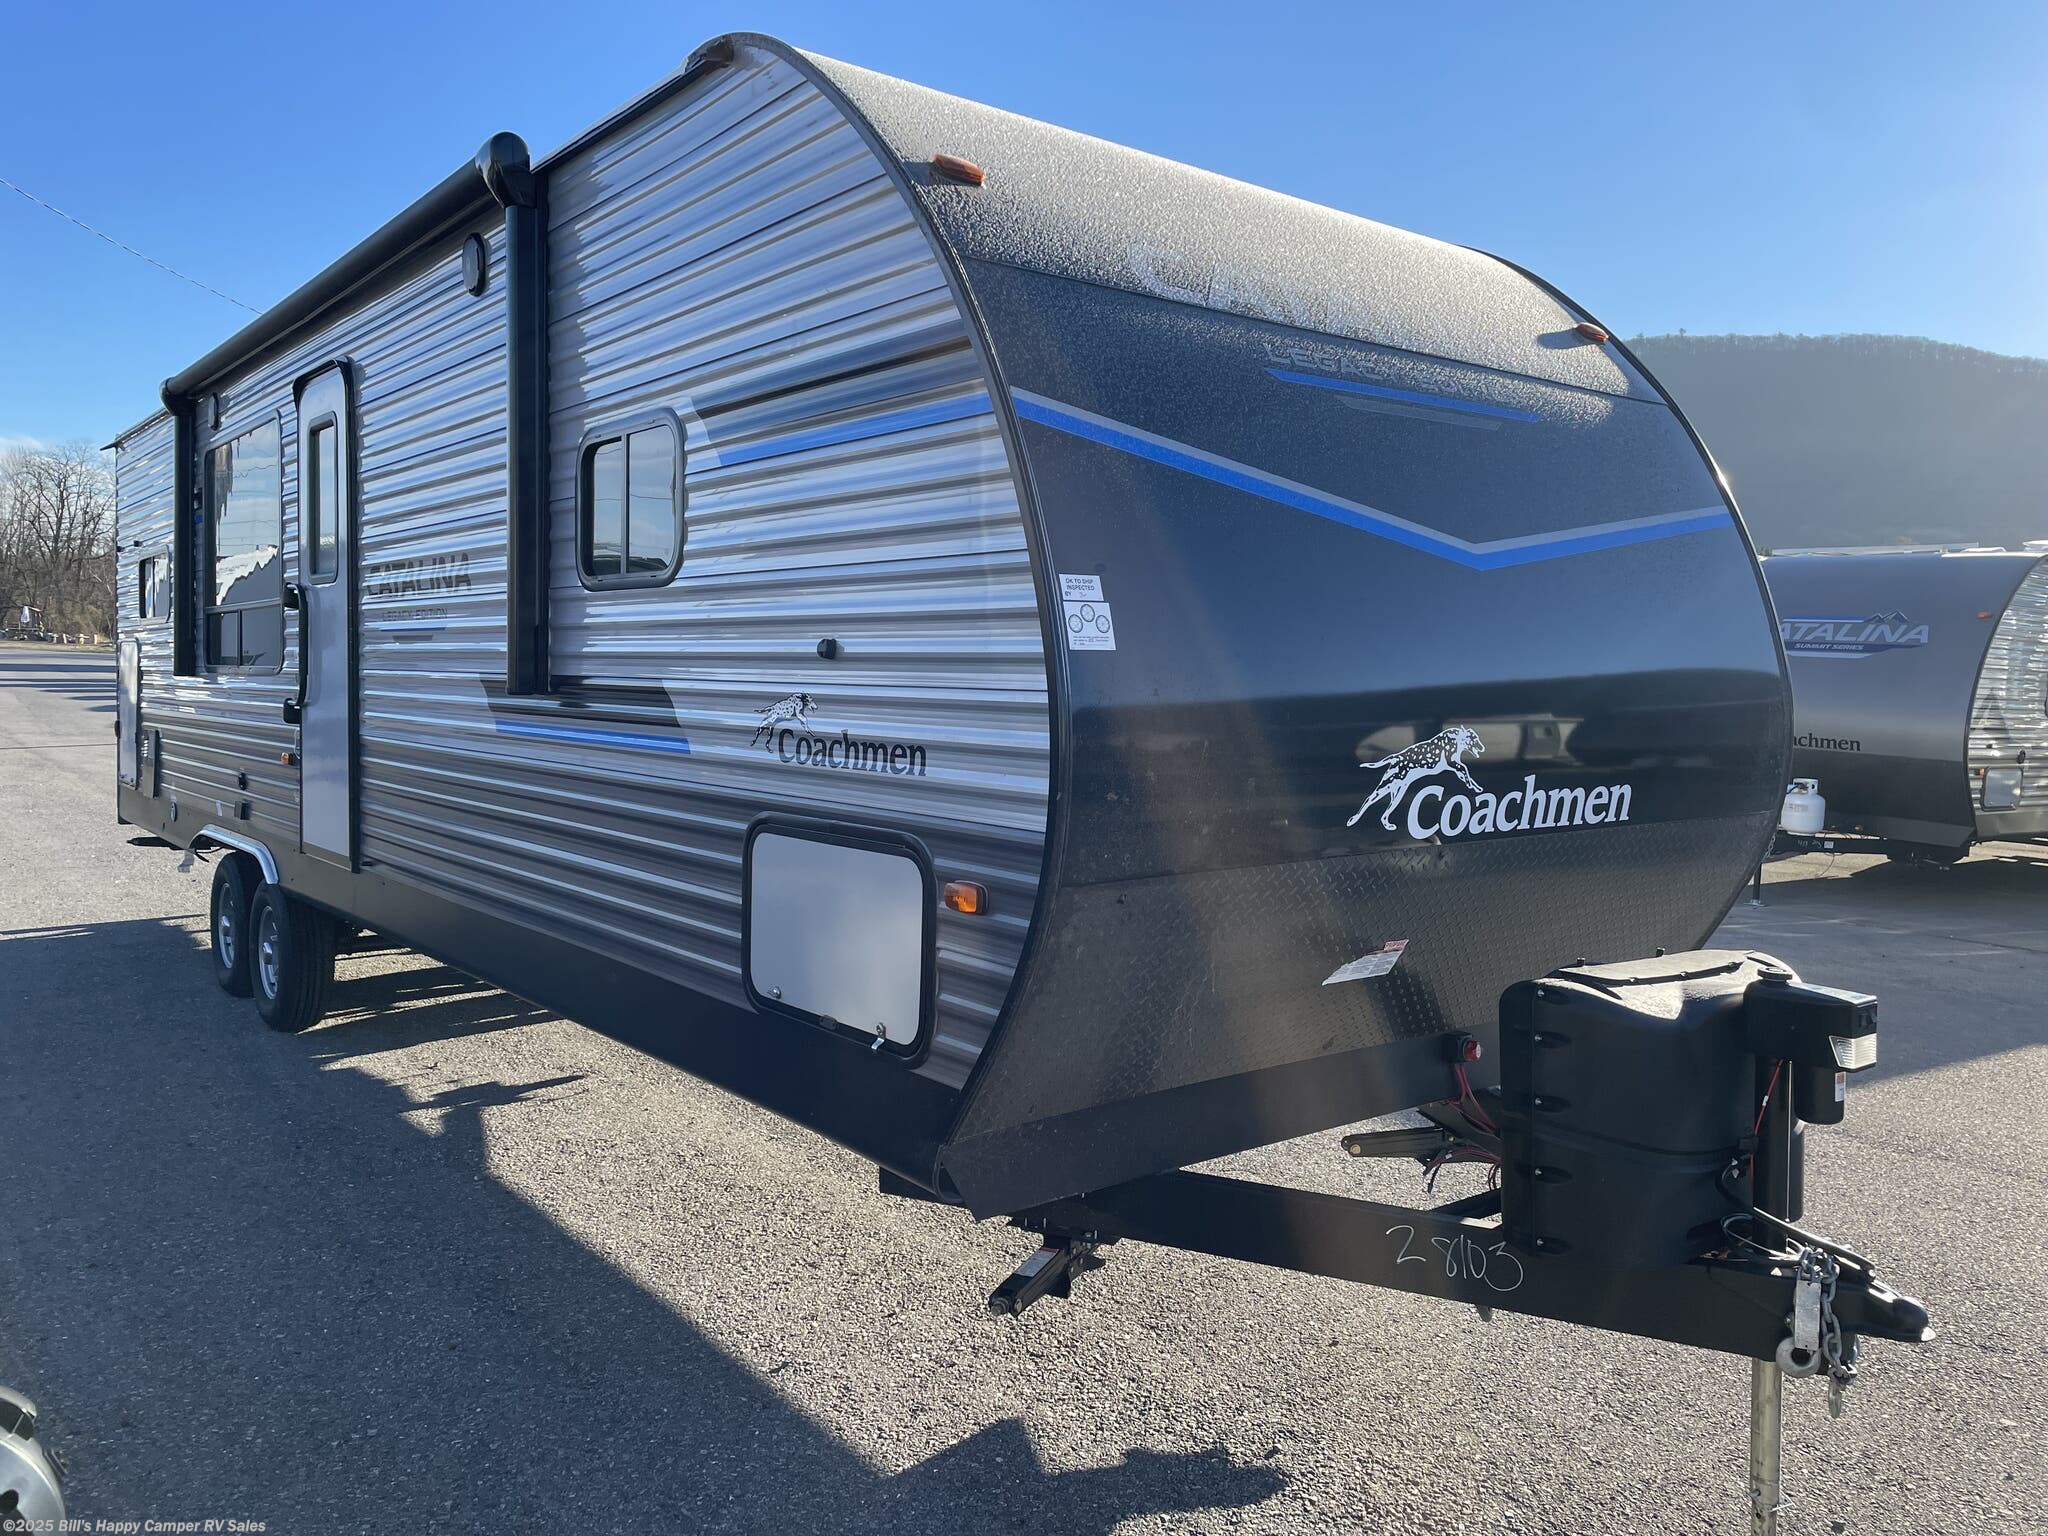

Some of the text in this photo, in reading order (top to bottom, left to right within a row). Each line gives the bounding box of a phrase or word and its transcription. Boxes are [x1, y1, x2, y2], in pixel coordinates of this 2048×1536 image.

[1780, 622, 1929, 643] ATALINA
[778, 728, 927, 777] Coachmen
[1794, 732, 1861, 752] chmen
[1407, 774, 1633, 841] Coachmen
